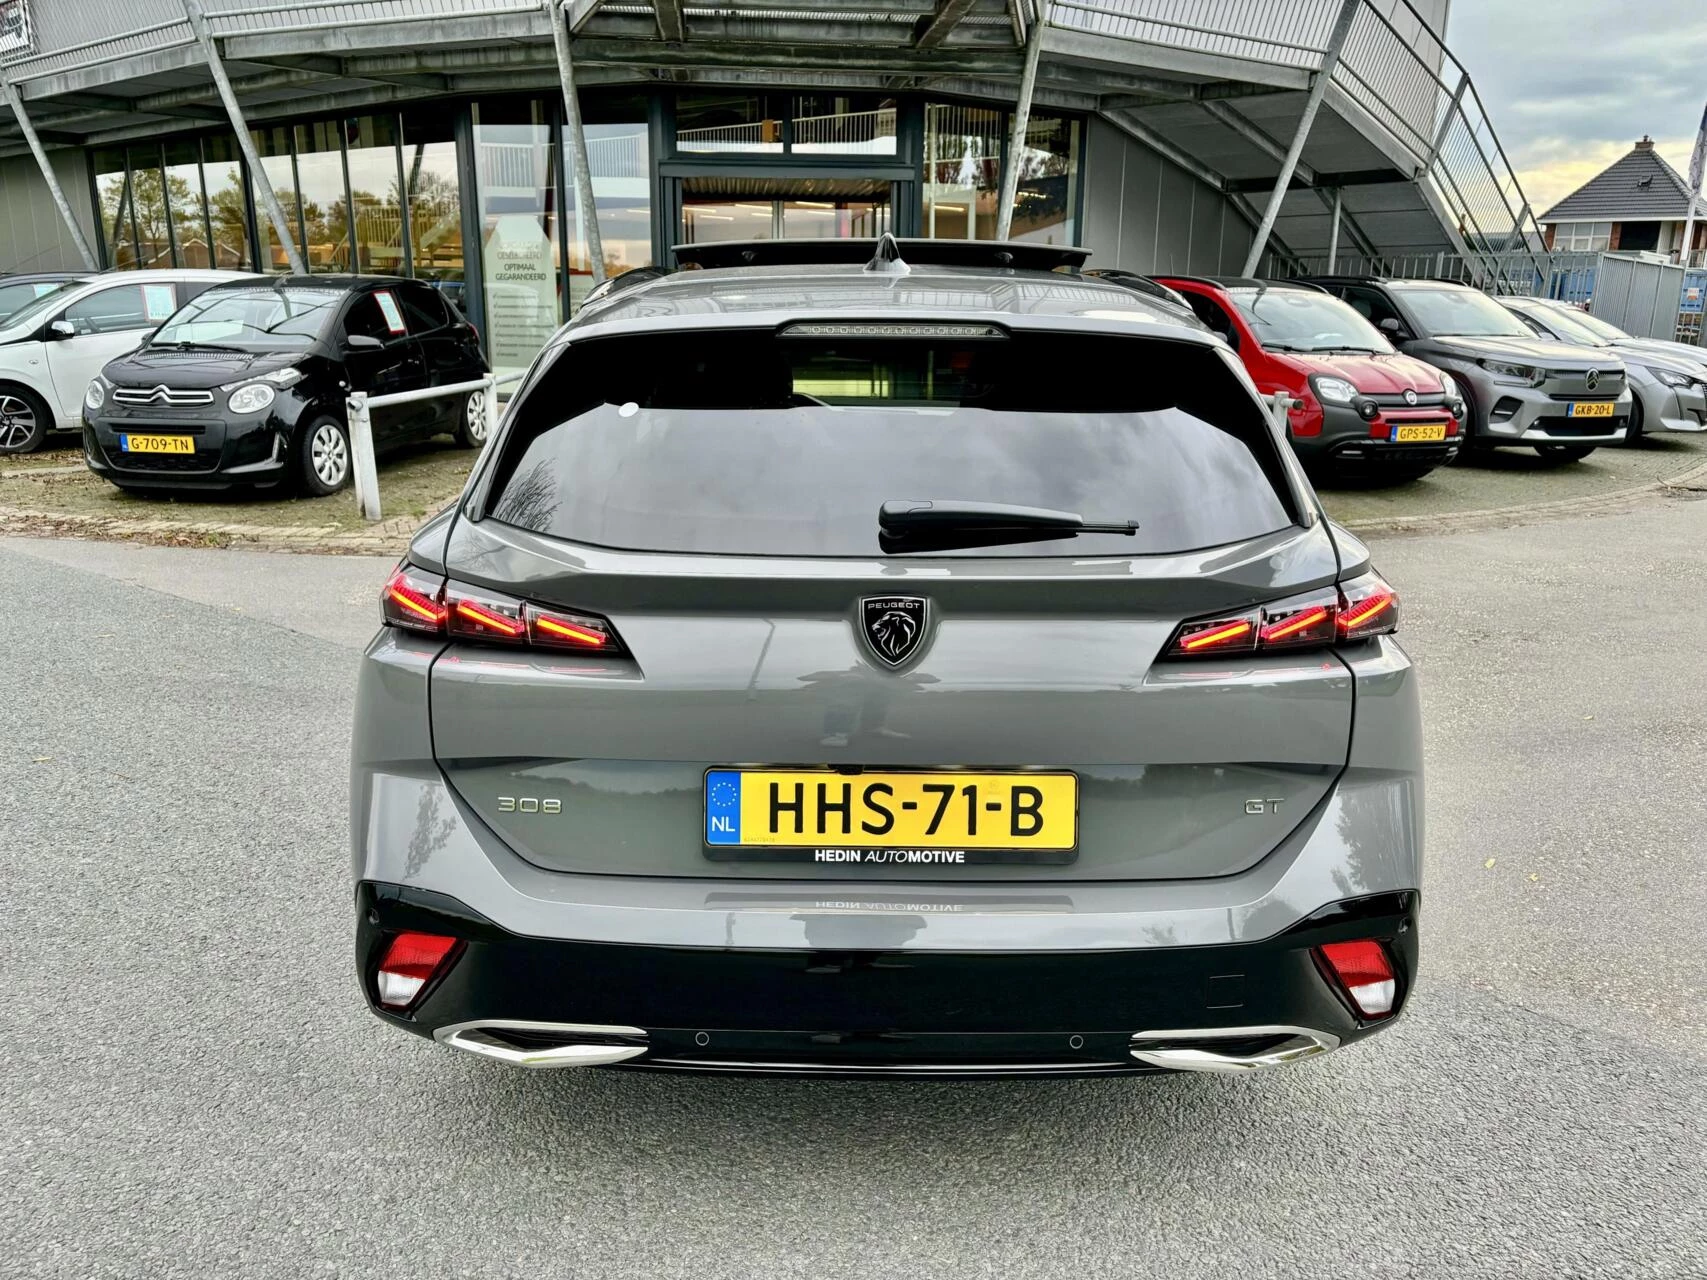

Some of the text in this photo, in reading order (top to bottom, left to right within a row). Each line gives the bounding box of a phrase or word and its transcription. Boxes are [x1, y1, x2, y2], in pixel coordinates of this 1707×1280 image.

[504, 263, 536, 271] OPTIMAAL
[495, 273, 547, 281] GEGARANDEERD
[1575, 405, 1611, 415] GKB-20-L
[1400, 427, 1442, 440] GPS-52-V
[131, 437, 189, 451] G-709-TN
[498, 796, 562, 814] 308
[769, 782, 1044, 837] HHS-71-B
[1245, 798, 1285, 814] GT
[712, 816, 735, 832] NL
[815, 850, 965, 864] HEDIN AUTOMOTIVE
